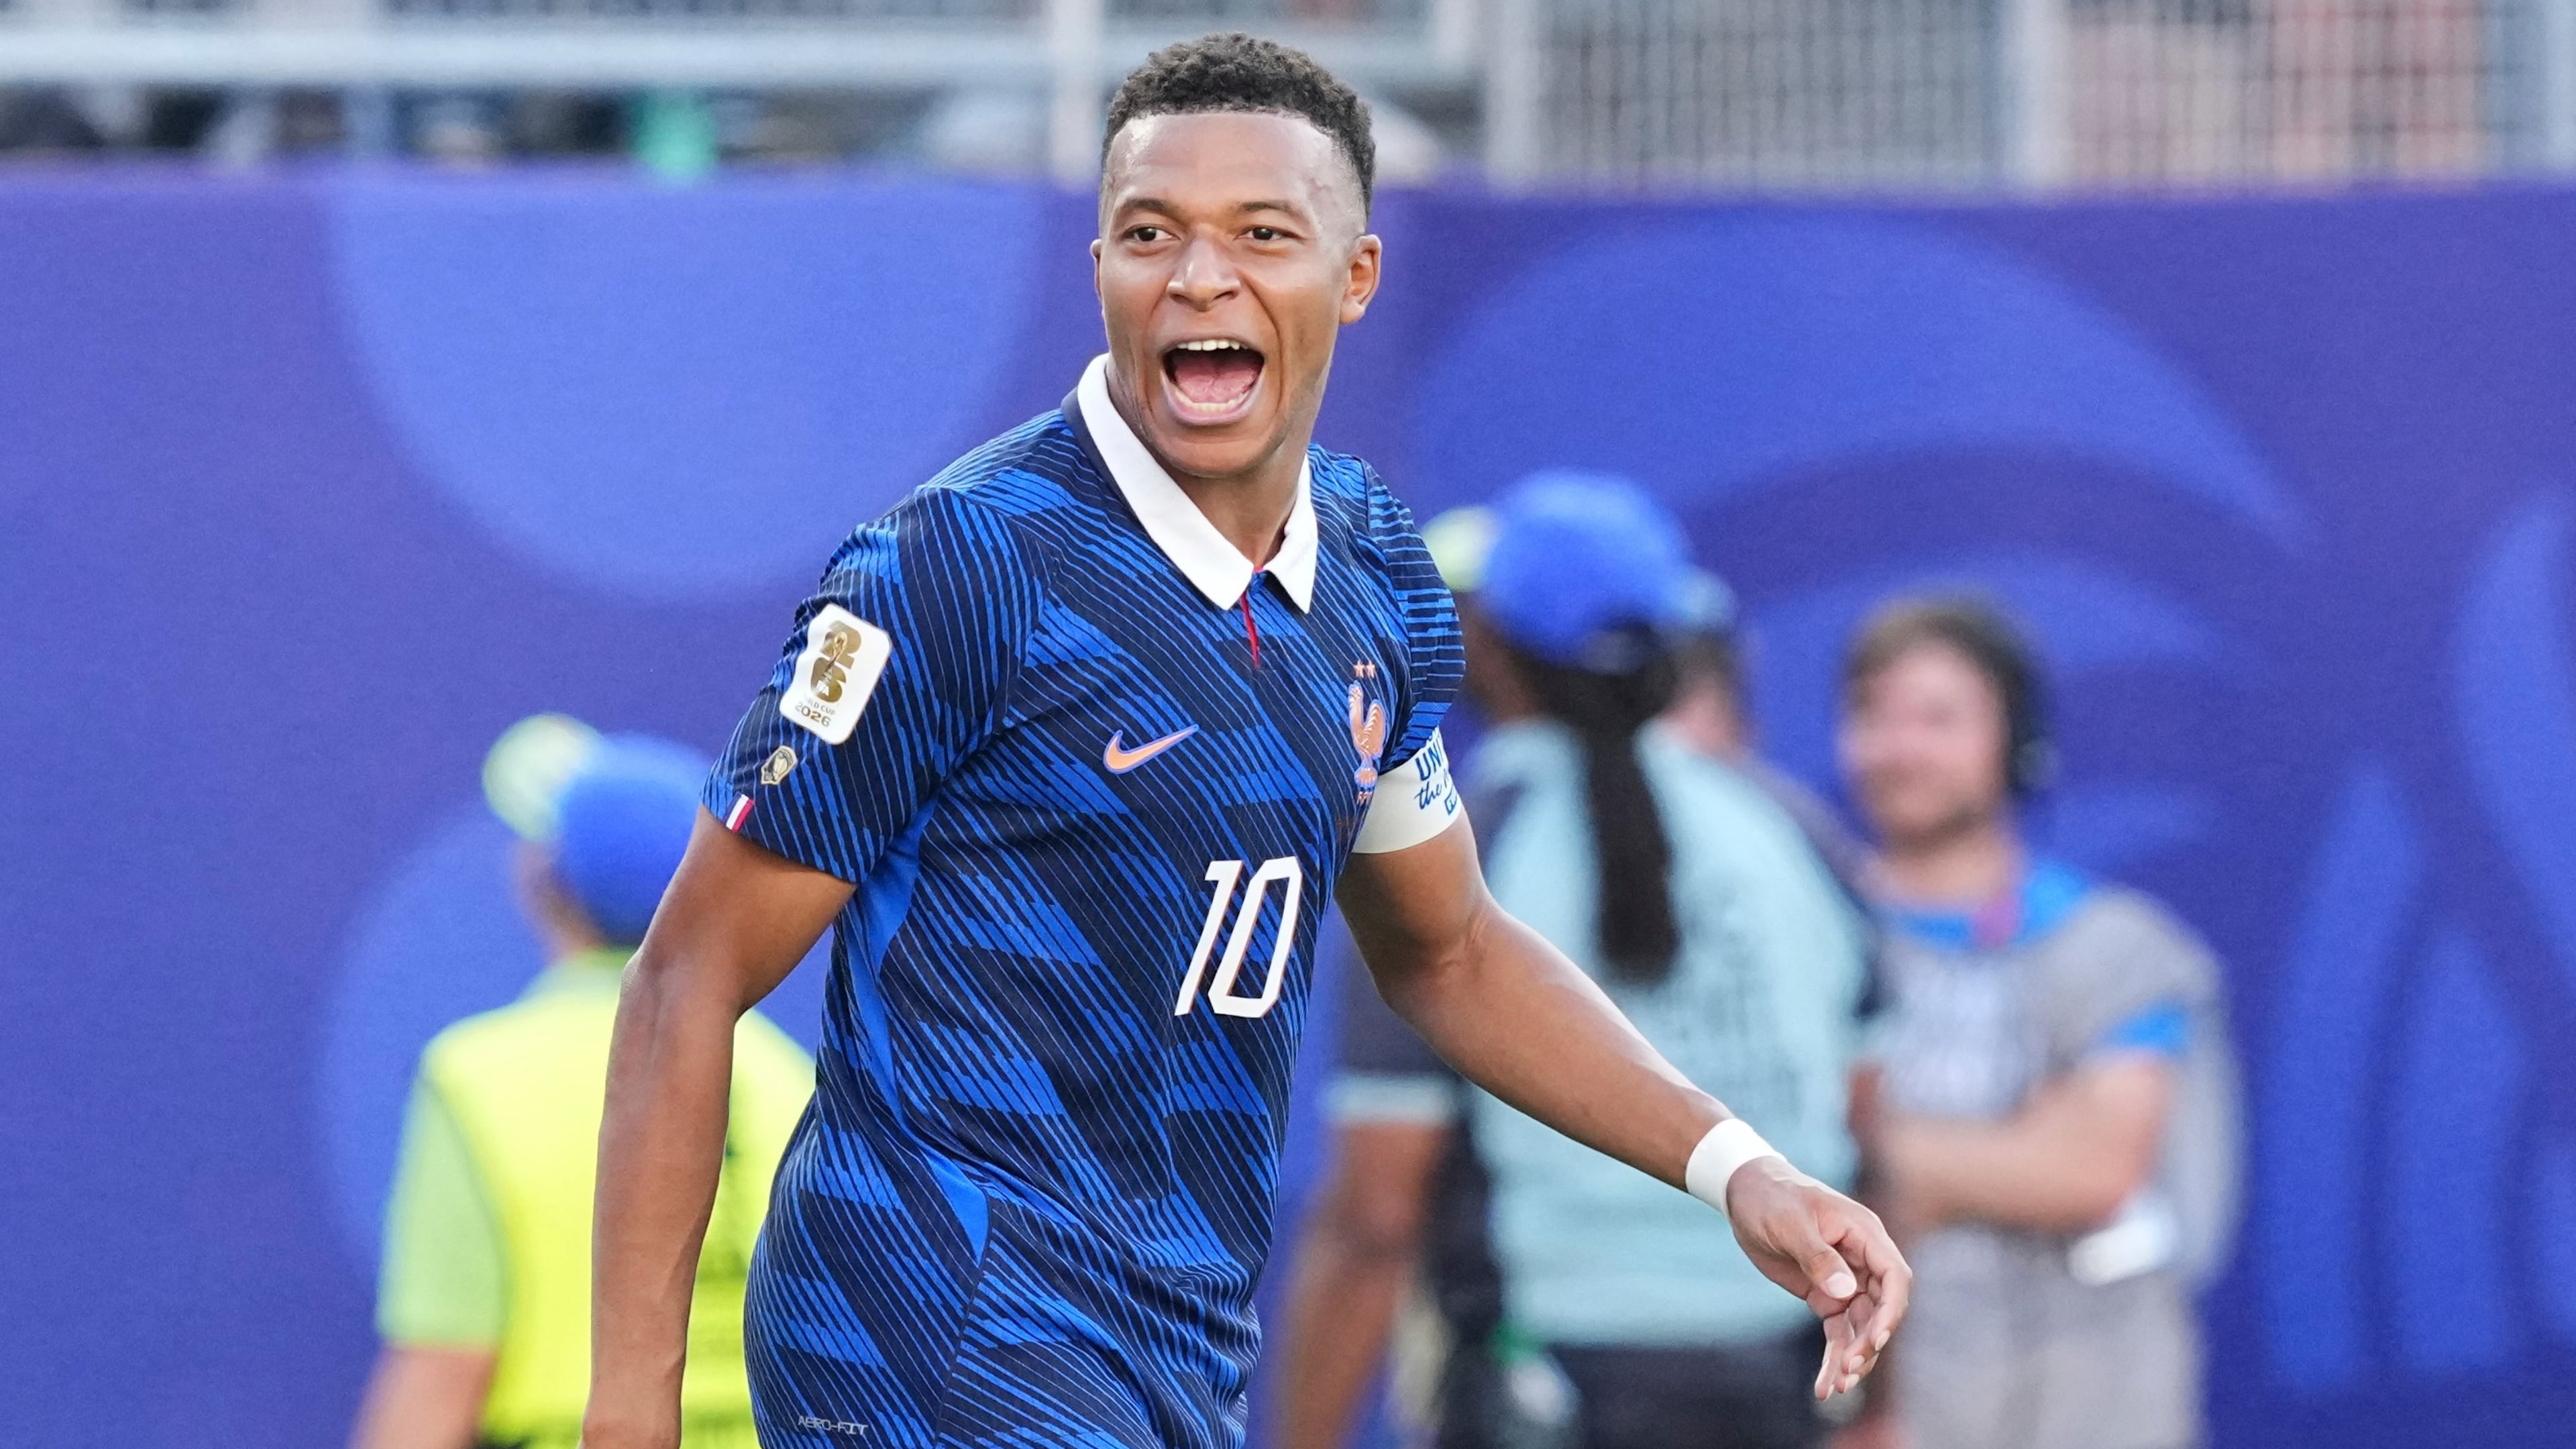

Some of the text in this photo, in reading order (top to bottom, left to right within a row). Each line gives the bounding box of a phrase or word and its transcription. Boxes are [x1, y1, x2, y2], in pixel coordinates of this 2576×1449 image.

[794, 701, 832, 727] 2026
[820, 704, 836, 716] CUP
[1415, 734, 1444, 782] UNI
[1413, 780, 1442, 810] the
[1174, 856, 1302, 1018] 10
[798, 1415, 869, 1436] AERO-FIT
